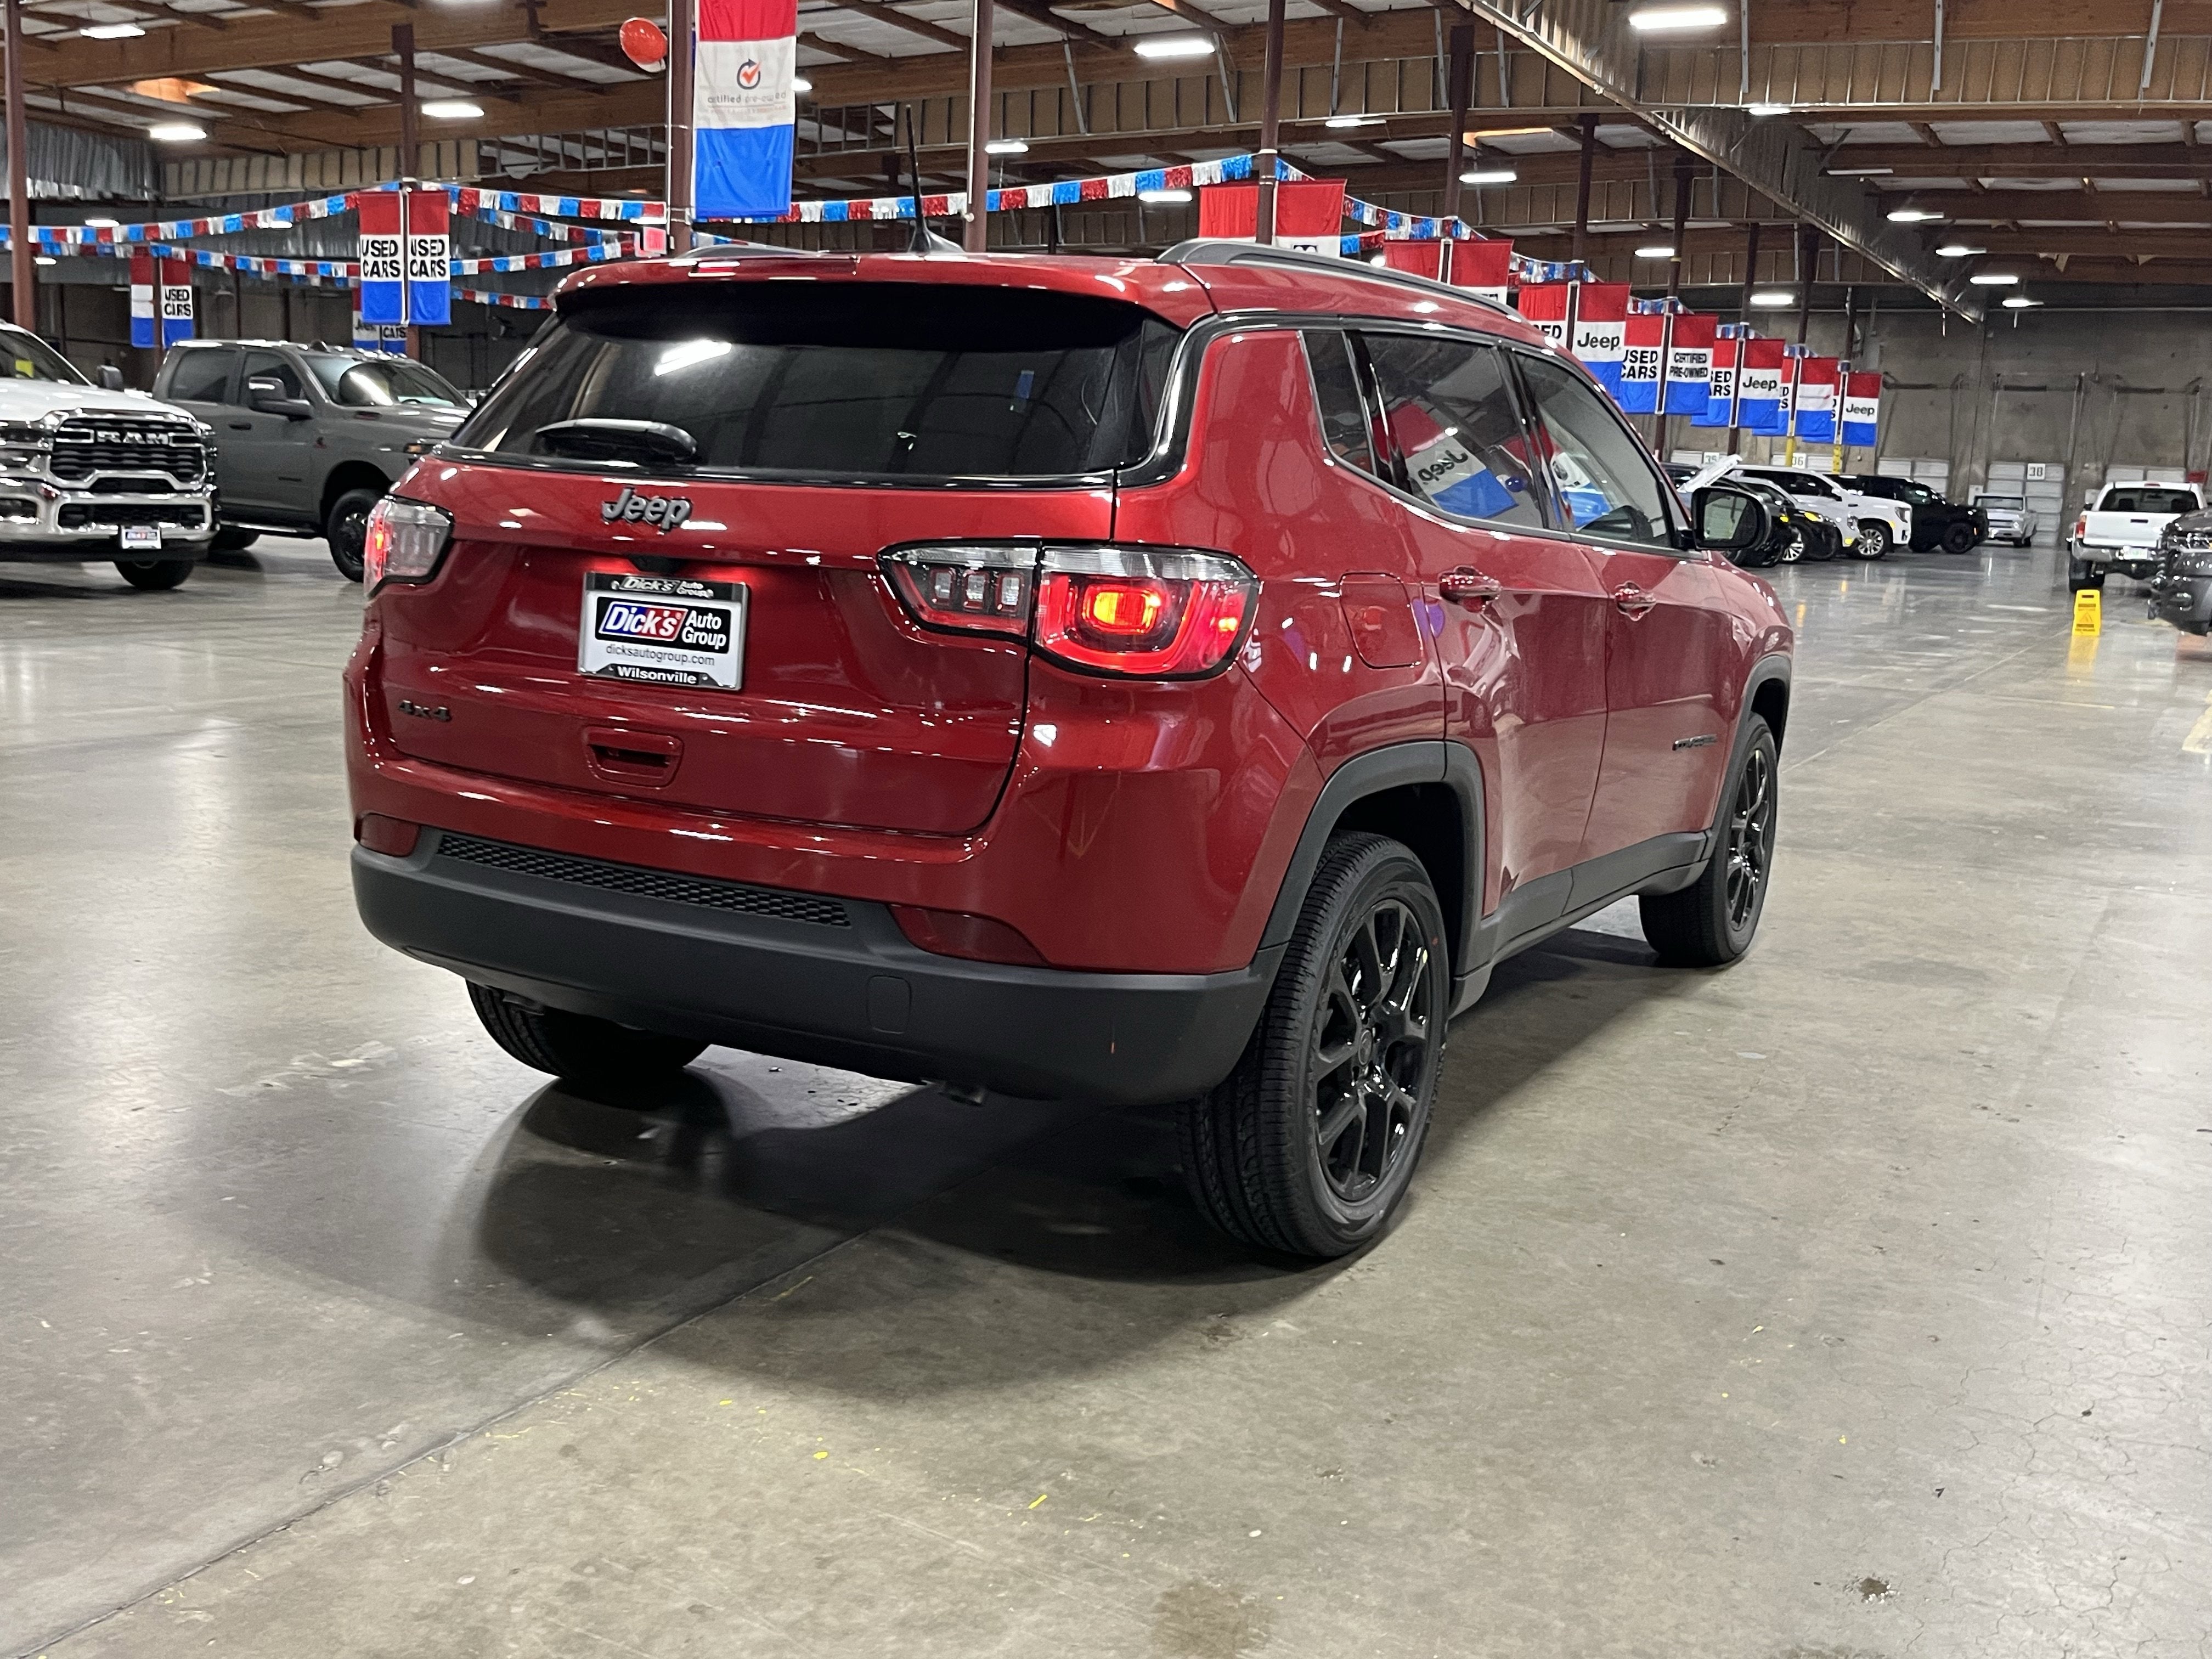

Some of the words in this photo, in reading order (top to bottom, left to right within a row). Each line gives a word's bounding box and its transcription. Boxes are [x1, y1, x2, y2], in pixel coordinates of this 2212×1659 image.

[362, 239, 398, 257] USED
[411, 238, 445, 257] USED
[363, 259, 401, 278] CARS
[410, 258, 446, 278] CARS
[165, 289, 190, 301] USED
[1577, 332, 1620, 351] Jeep
[1709, 385, 1731, 396] RS
[1742, 376, 1778, 391] Jeep
[1846, 404, 1875, 416] Jeep
[96, 430, 169, 444] RAM
[602, 486, 692, 532] Jeep
[624, 578, 679, 592] Dick's
[605, 606, 678, 637] Dick's
[685, 610, 722, 630] Auto
[681, 627, 727, 650] Group
[606, 643, 715, 667] dicksautogroup.com
[617, 664, 697, 685] Wilsonville
[398, 699, 452, 722] 4x4
